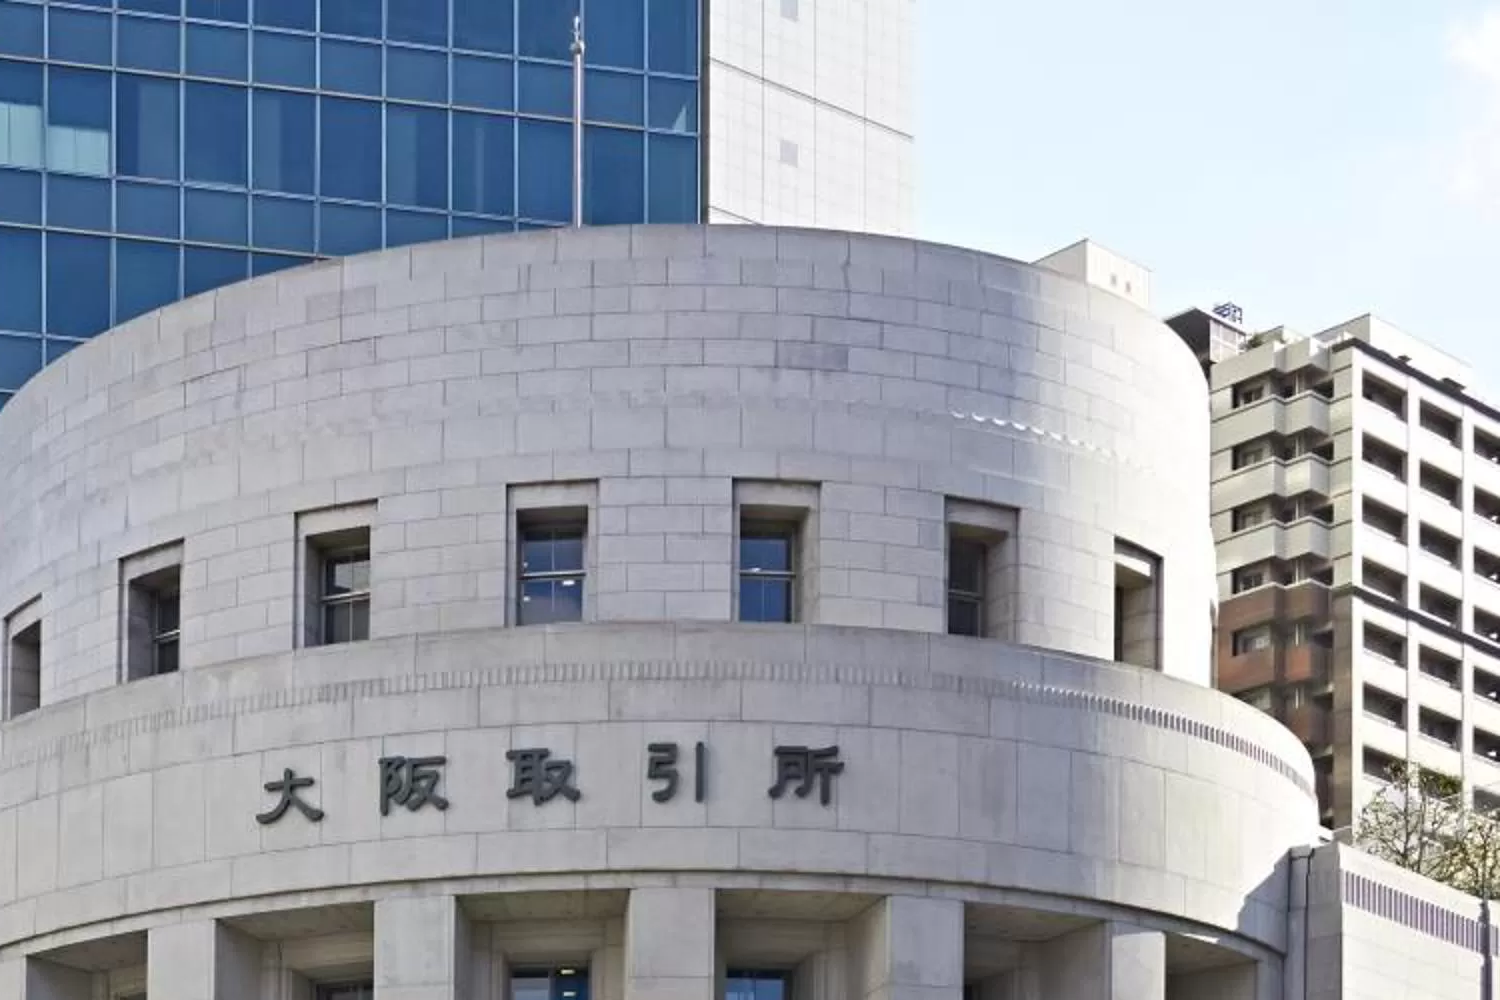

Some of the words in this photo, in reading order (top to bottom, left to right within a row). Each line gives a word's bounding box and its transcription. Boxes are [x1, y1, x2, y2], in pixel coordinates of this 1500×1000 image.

[256, 741, 845, 824] 大阪取引所
